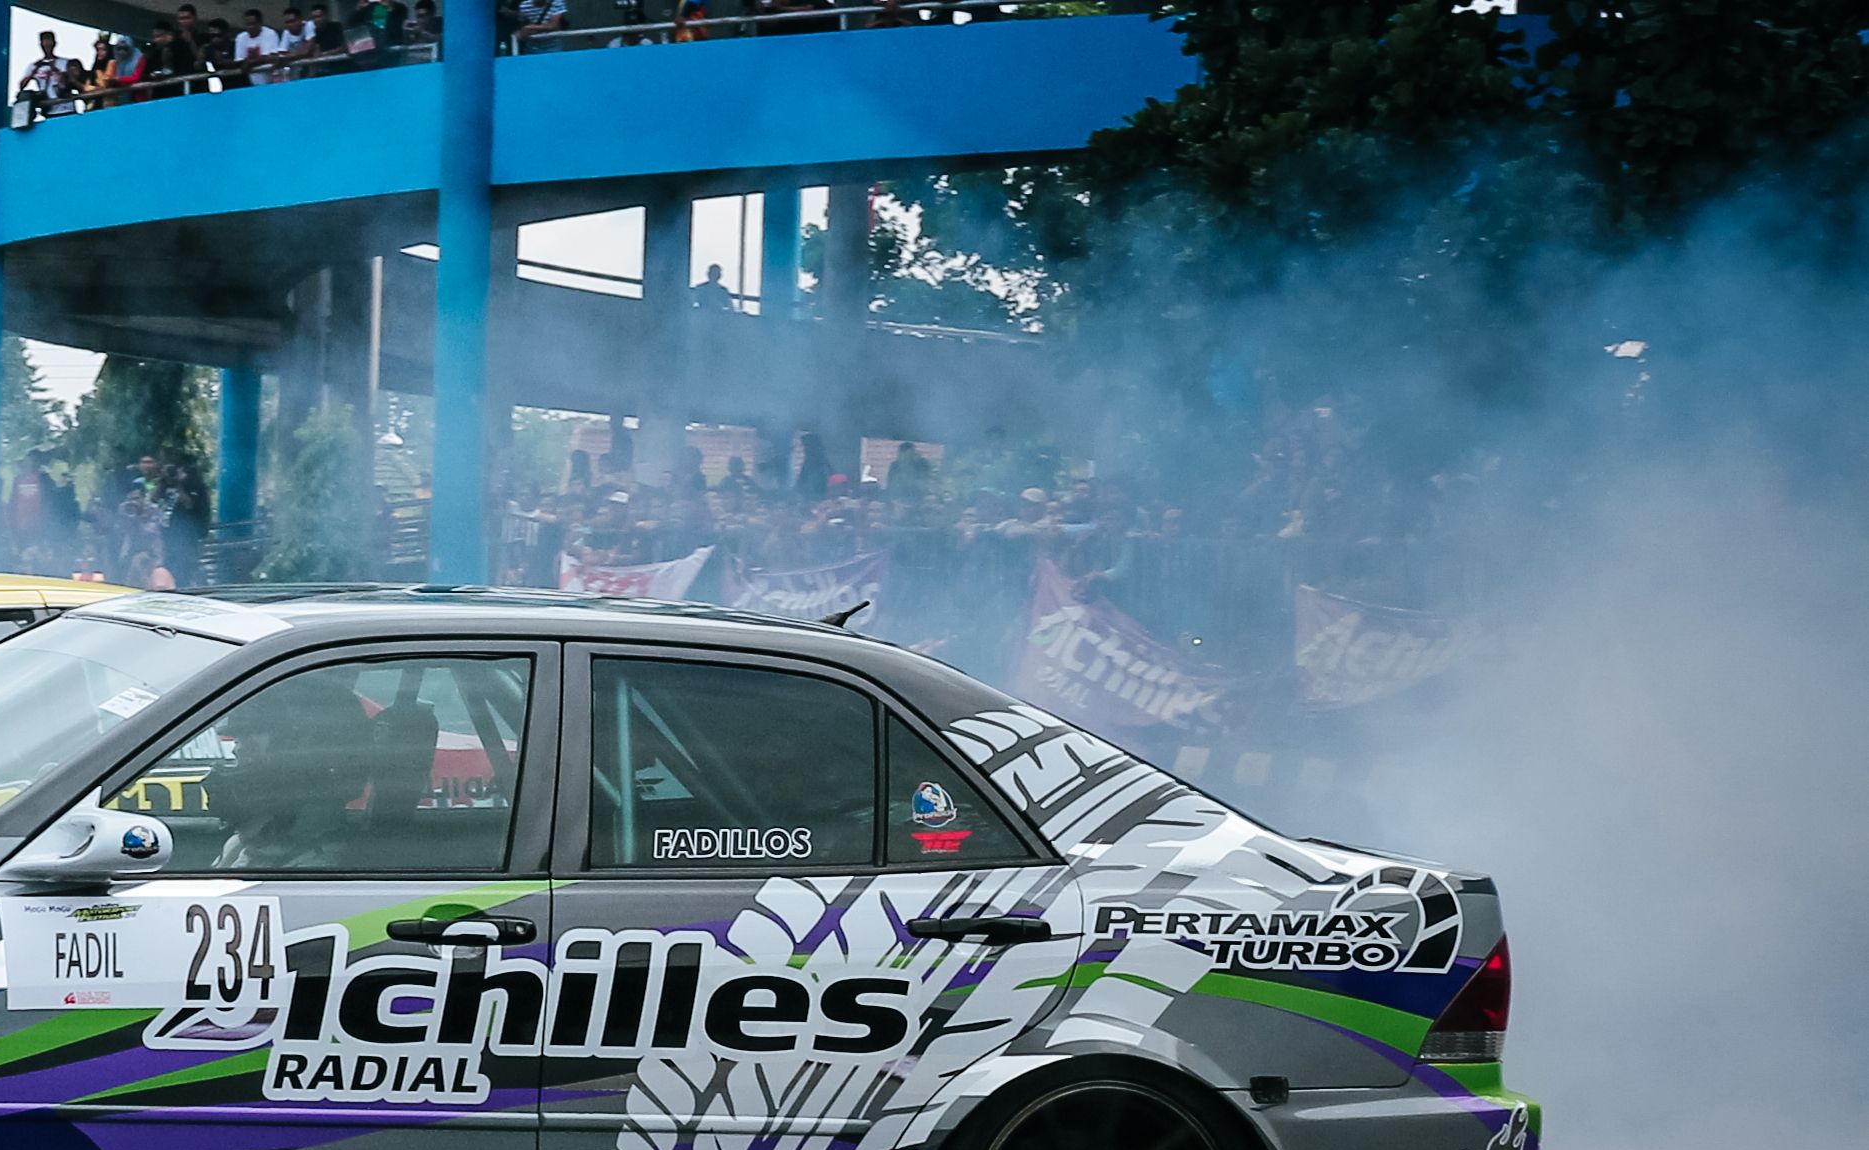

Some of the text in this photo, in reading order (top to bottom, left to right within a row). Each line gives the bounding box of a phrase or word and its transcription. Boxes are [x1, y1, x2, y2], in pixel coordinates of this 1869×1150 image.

[652, 827, 813, 860] FADILLOS
[1094, 906, 1397, 940] PERTAMAX
[55, 932, 124, 979] FADIL
[185, 903, 275, 1003] 234
[1212, 939, 1397, 969] TURBO
[270, 1053, 481, 1095] RADIAL
